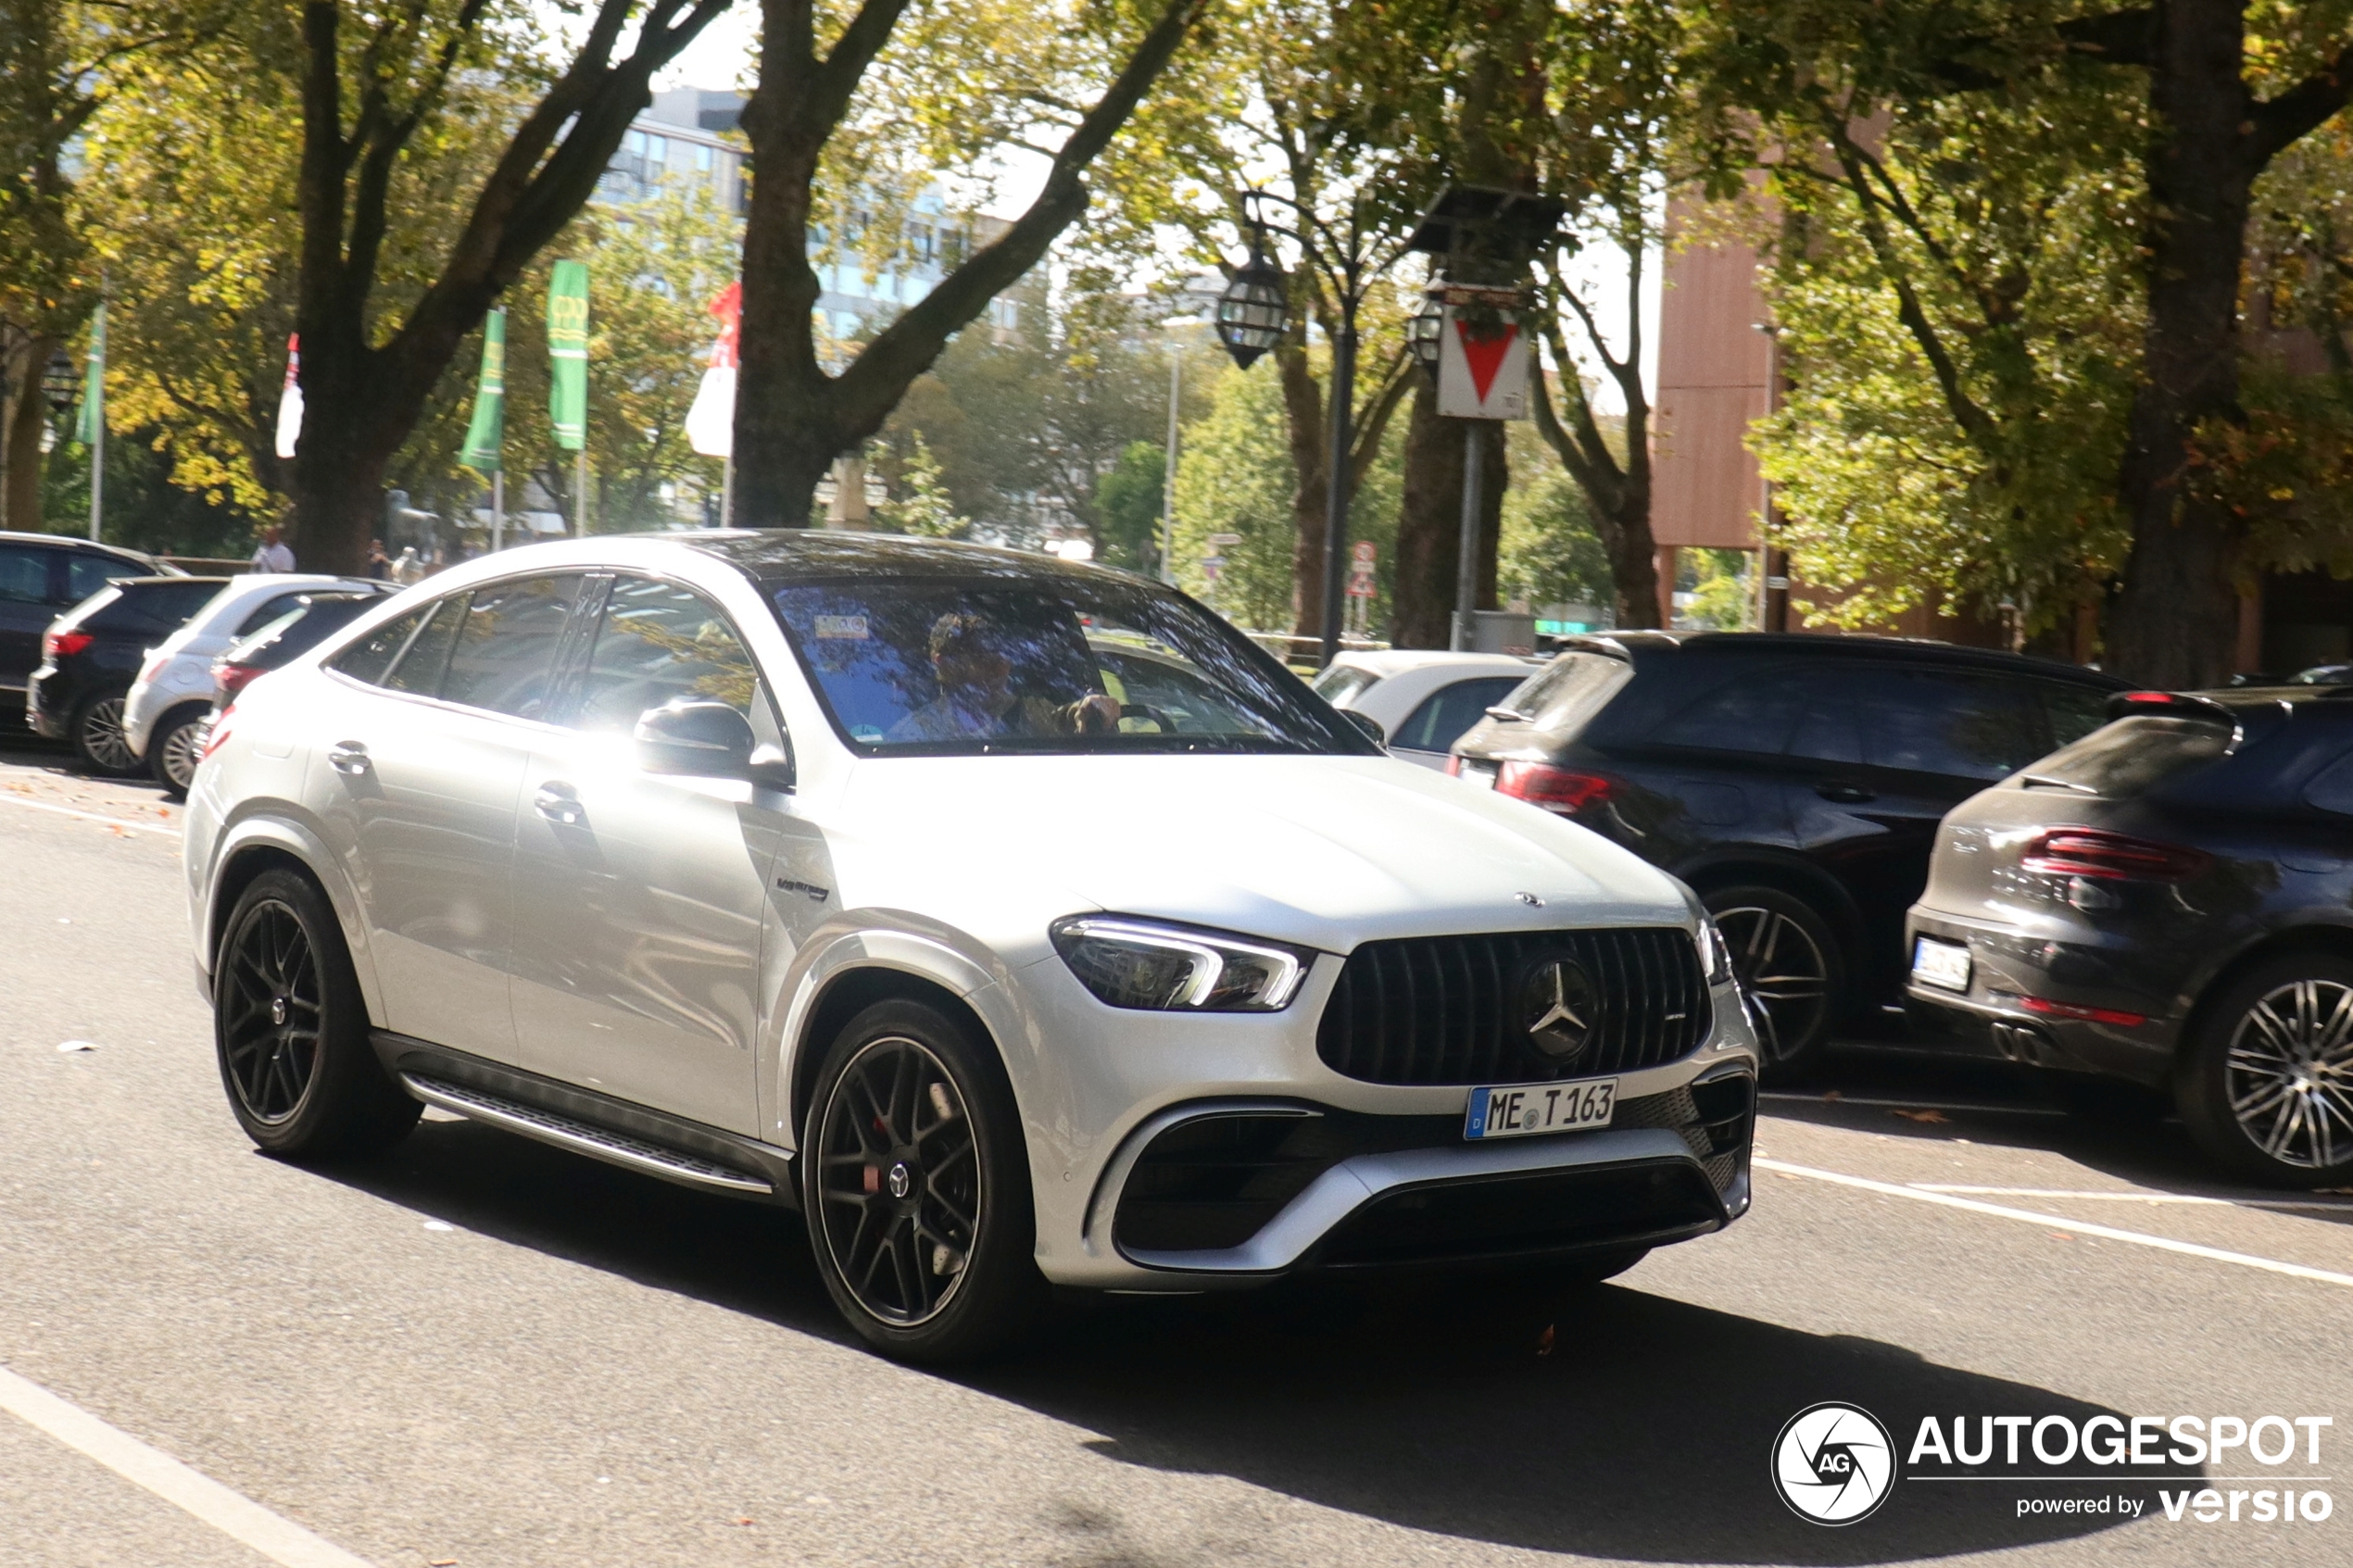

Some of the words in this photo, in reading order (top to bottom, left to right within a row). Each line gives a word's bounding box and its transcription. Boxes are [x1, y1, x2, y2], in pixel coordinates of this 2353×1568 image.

[1487, 1093, 1525, 1131] ME
[1545, 1089, 1561, 1126] T
[1564, 1084, 1614, 1124] 163
[1472, 1118, 1481, 1129] D
